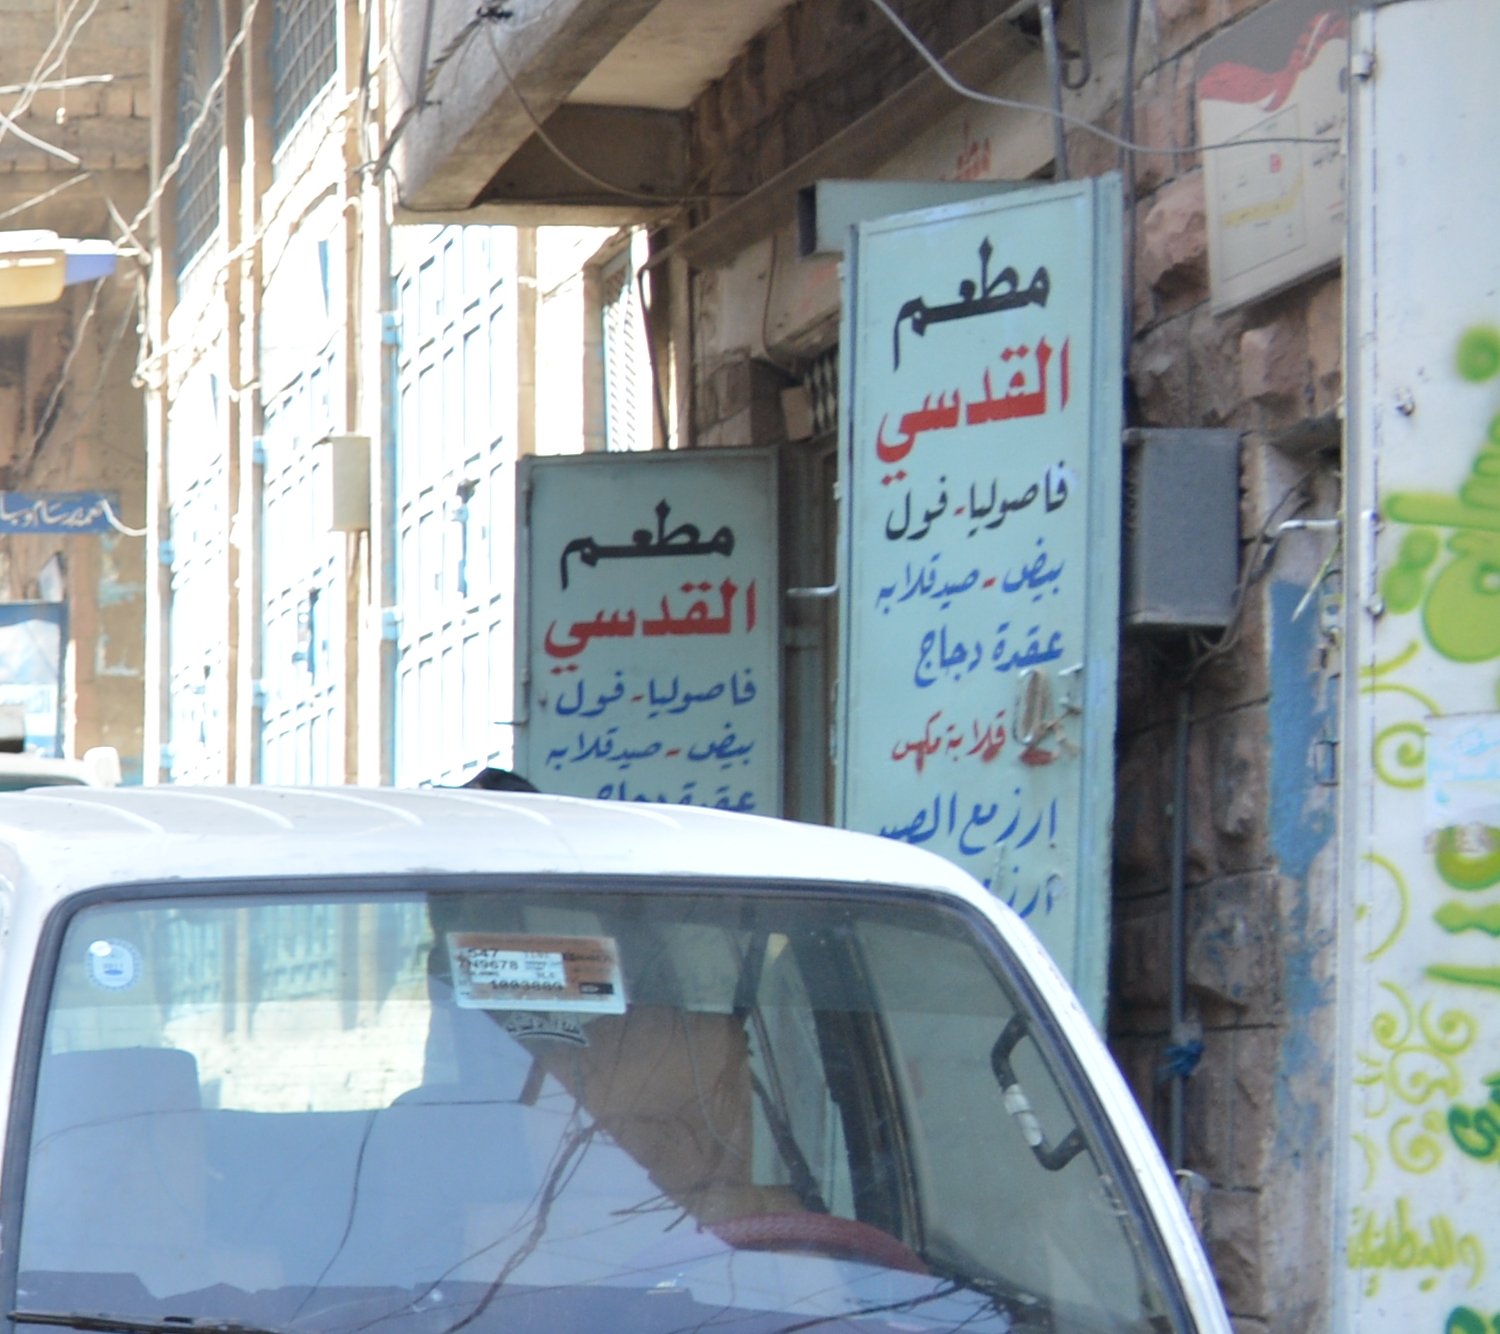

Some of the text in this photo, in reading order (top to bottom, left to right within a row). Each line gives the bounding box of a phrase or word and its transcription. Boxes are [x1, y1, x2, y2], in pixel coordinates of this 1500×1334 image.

[893, 235, 1052, 373] مطعم
[876, 335, 1070, 487] القدسي
[885, 460, 1068, 541] فاصوليا فول
[560, 498, 735, 591] مطعم
[1001, 536, 1066, 603] بيض
[544, 577, 756, 675] القدسي
[913, 622, 1066, 688] عقدة دجاج
[556, 669, 756, 717] فاصوليا فول
[687, 722, 754, 768] بيض
